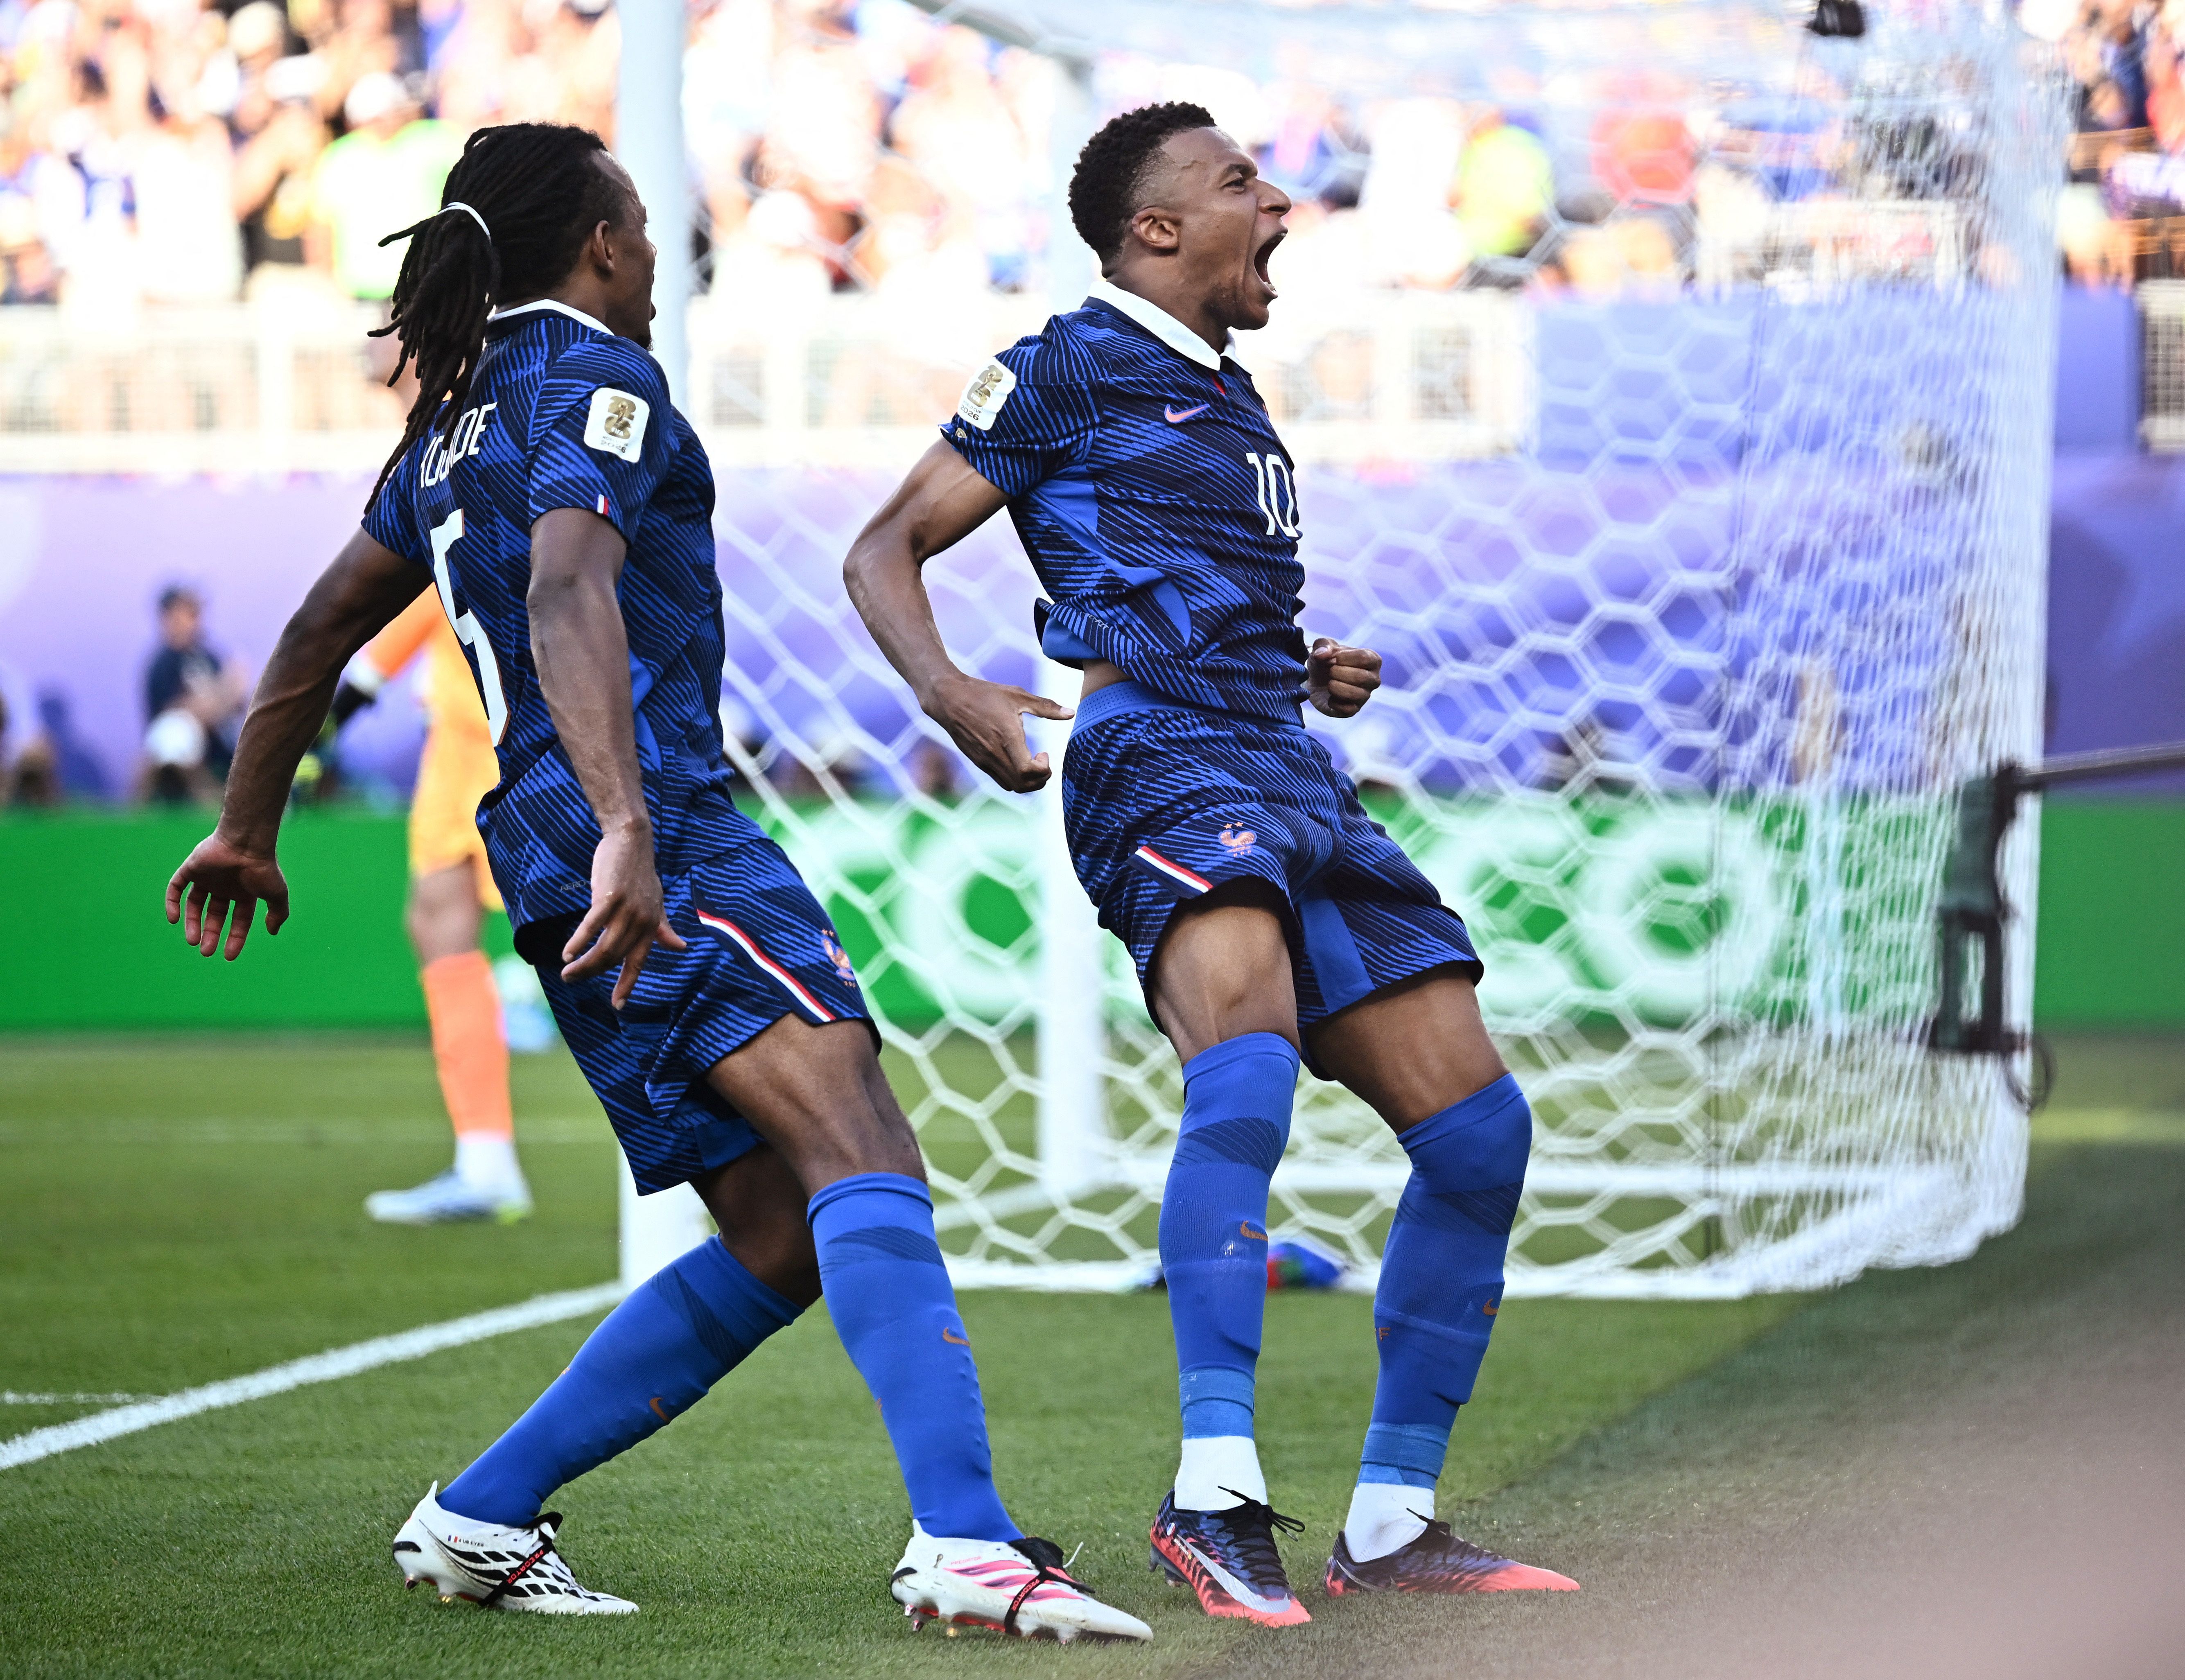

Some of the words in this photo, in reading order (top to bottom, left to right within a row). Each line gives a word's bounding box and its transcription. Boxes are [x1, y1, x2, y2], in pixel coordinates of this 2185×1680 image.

[960, 404, 979, 420] 2026
[601, 440, 626, 453] 2026
[1245, 452, 1299, 537] 10
[430, 508, 511, 747] 5
[507, 1549, 544, 1584] PREDATOR
[1011, 1578, 1040, 1612] PREDATOR
